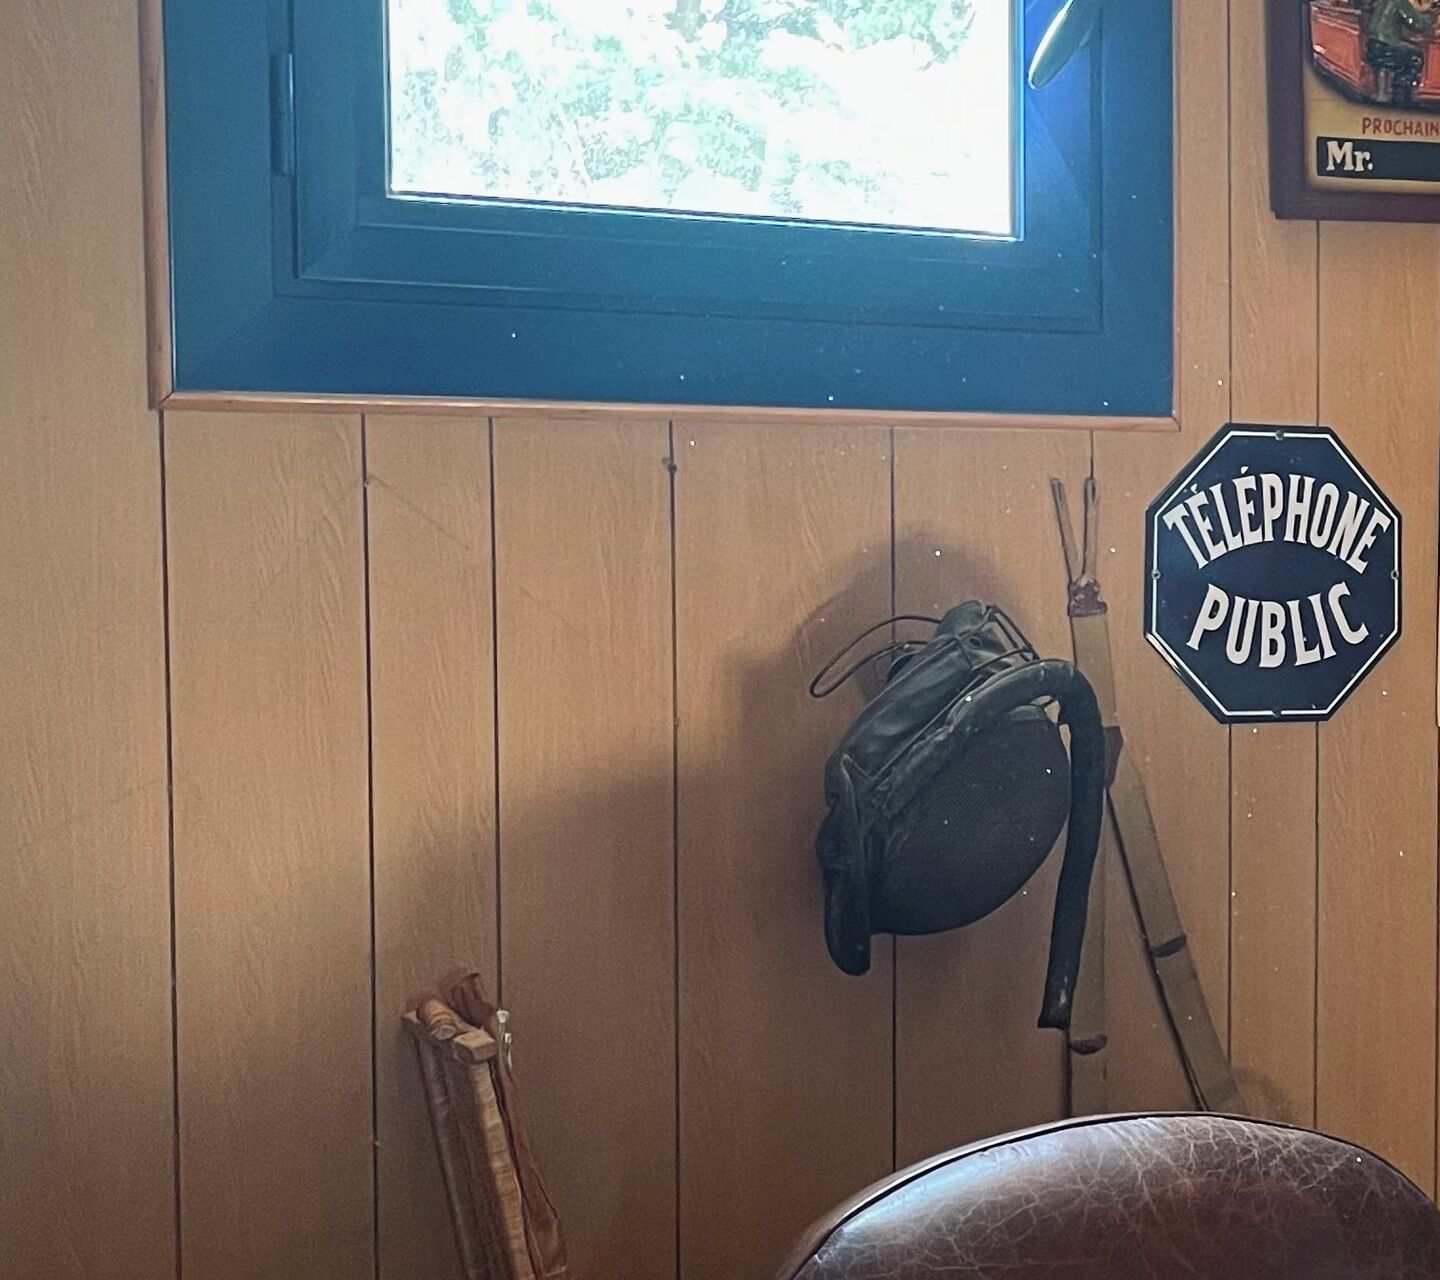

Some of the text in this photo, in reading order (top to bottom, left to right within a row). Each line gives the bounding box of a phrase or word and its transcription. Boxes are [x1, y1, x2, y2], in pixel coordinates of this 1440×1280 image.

[1326, 141, 1373, 172] Mr.
[1162, 466, 1392, 575] TÉLÉPHONE
[1186, 581, 1369, 668] PUBLIC
